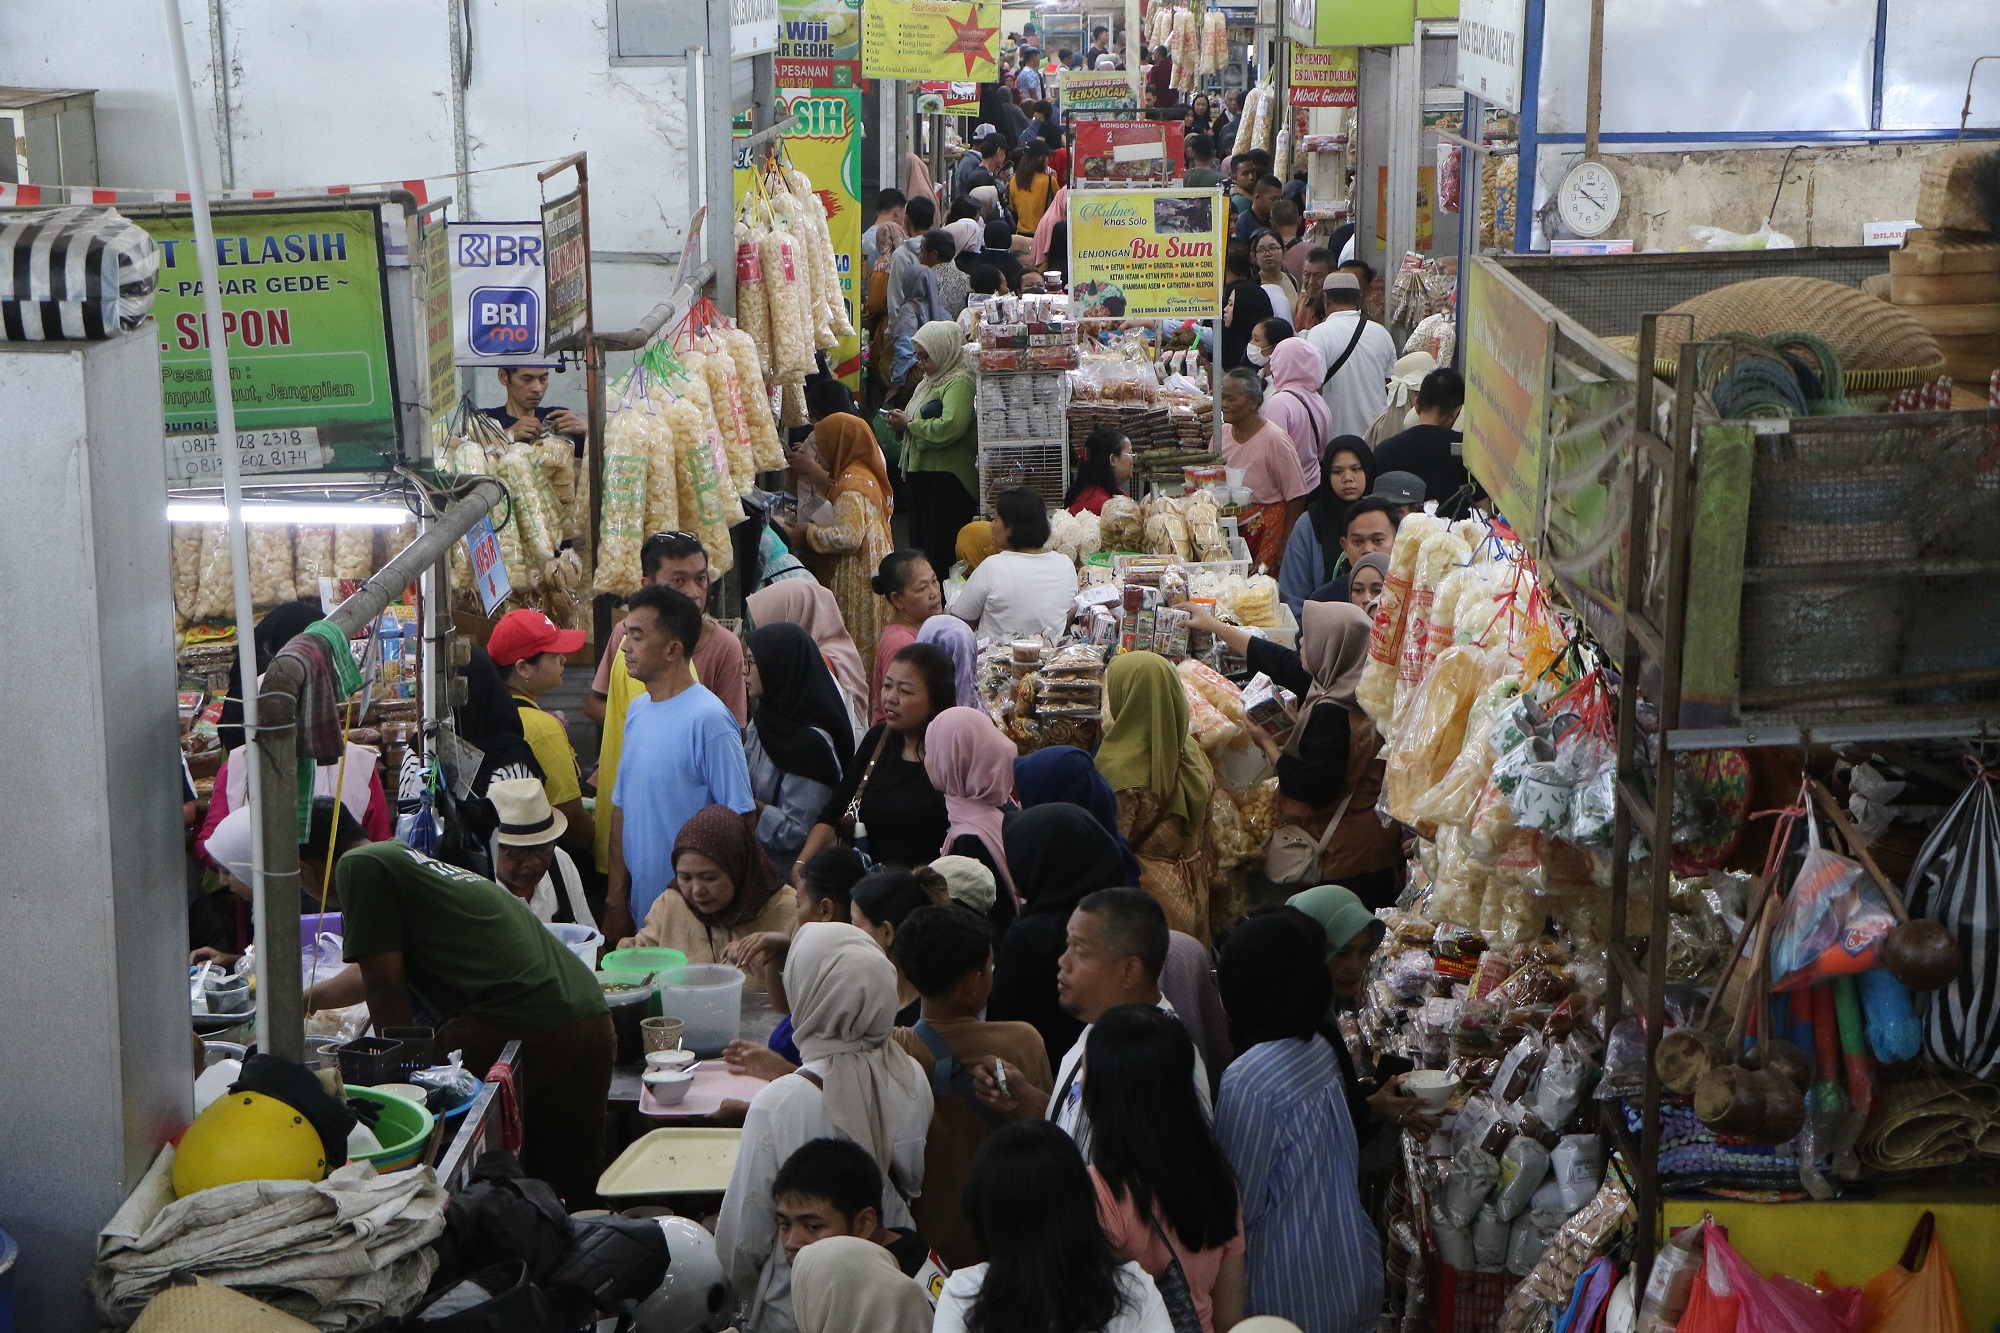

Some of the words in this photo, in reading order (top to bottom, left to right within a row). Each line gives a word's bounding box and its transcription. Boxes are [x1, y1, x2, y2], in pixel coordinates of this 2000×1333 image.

[787, 22, 828, 42] Wiji
[794, 43, 834, 58] GEDHE
[782, 65, 828, 77] PESANAN
[1304, 70, 1328, 81] DAWET
[1329, 70, 1357, 81] DURIAN
[1066, 80, 1093, 88] KULINER
[1094, 79, 1111, 87] KHAS
[1070, 87, 1126, 101] LENJONGAN
[1294, 88, 1320, 102] Mbak
[1321, 88, 1357, 103] Genduk
[1587, 171, 1594, 179] 12
[1571, 193, 1576, 201] 9
[1079, 198, 1136, 222] Kuliner
[1572, 204, 1578, 212] 8
[1104, 218, 1126, 226] Khas
[1128, 217, 1147, 226] Solo
[1578, 212, 1583, 220] 7
[1595, 212, 1600, 220] 5
[191, 232, 348, 268] ELASIH
[496, 235, 545, 266] BR
[1078, 249, 1130, 259] LENJONGAN
[1129, 237, 1159, 259] Bu
[1165, 236, 1213, 258] Sum
[265, 275, 330, 293] GEDE
[1109, 273, 1124, 281] KETAN
[1148, 282, 1161, 290] ASEM
[482, 303, 528, 325] BRI
[490, 327, 528, 342] mo
[267, 381, 355, 402] Janggilan
[262, 431, 302, 446] 2318
[272, 450, 307, 466] 8174
[474, 532, 498, 580] KASIR
